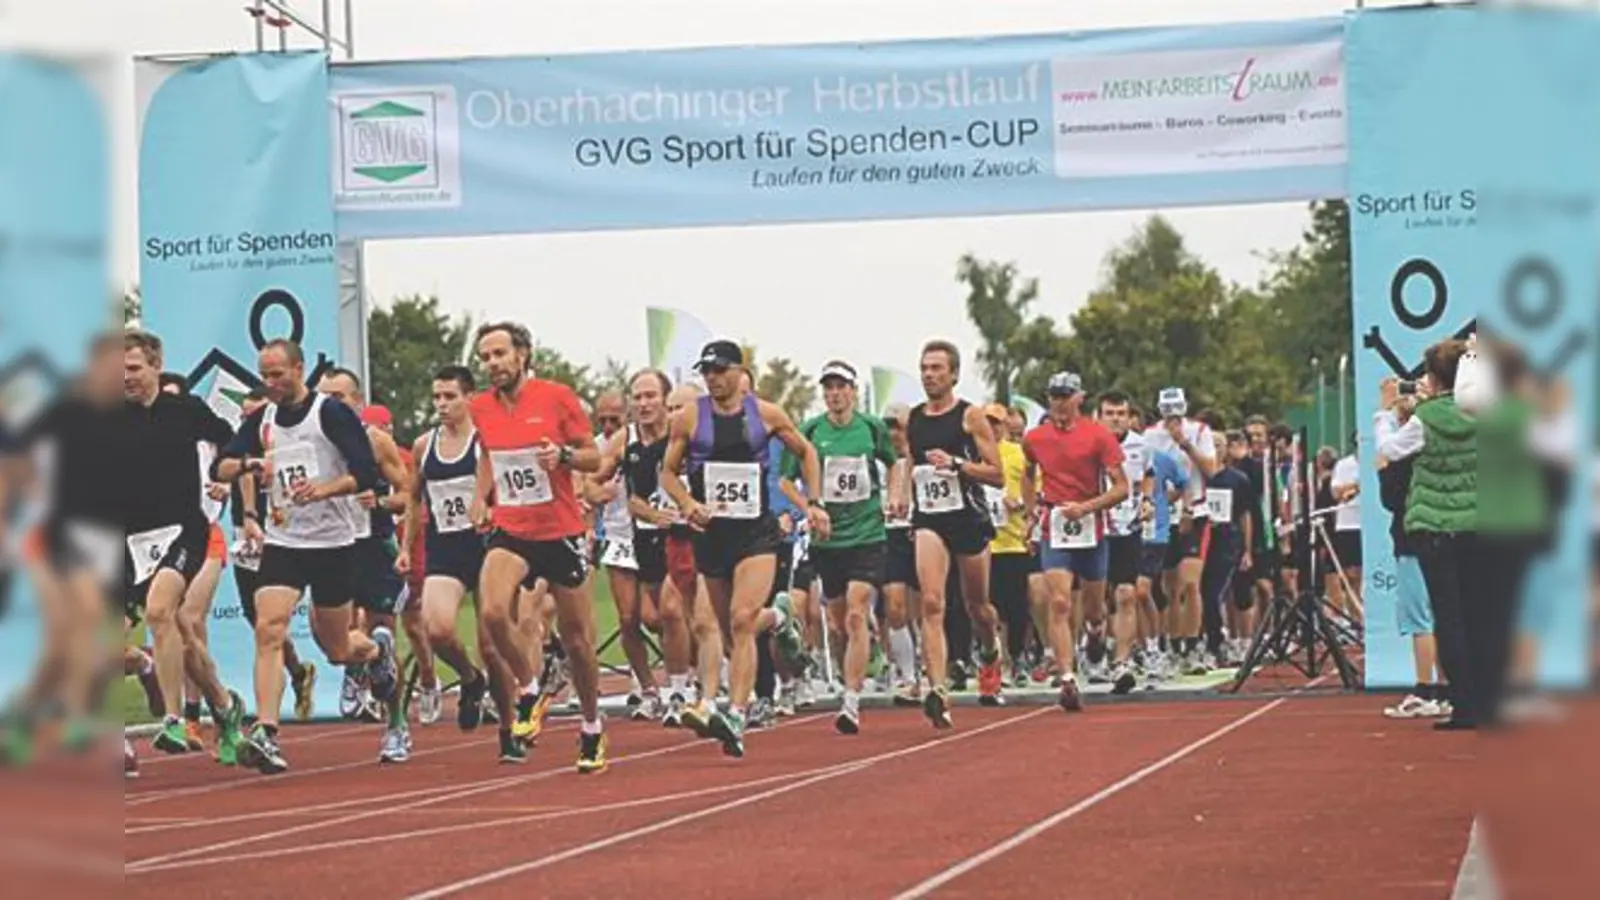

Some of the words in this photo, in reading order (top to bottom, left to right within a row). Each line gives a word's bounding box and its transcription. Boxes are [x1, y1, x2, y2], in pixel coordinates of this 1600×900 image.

[465, 81, 791, 129] Oberhachinger
[813, 60, 1041, 114] Herbstlauf
[350, 119, 428, 164] GVG
[574, 136, 652, 167] GVG
[662, 133, 748, 168] Sport
[756, 129, 797, 161] für
[752, 164, 823, 189] Laufen
[829, 163, 858, 185] für
[862, 160, 901, 184] den
[906, 161, 966, 185] guten
[971, 156, 1040, 178] Zweck
[1356, 192, 1416, 218] Sport
[1423, 189, 1453, 212] für
[145, 237, 202, 261] Sport
[207, 235, 233, 255] für
[237, 229, 334, 256] Spenden
[503, 467, 537, 491] 105
[715, 482, 749, 502] 254
[838, 474, 858, 491] 68
[924, 480, 950, 500] 193
[443, 496, 466, 518] 28
